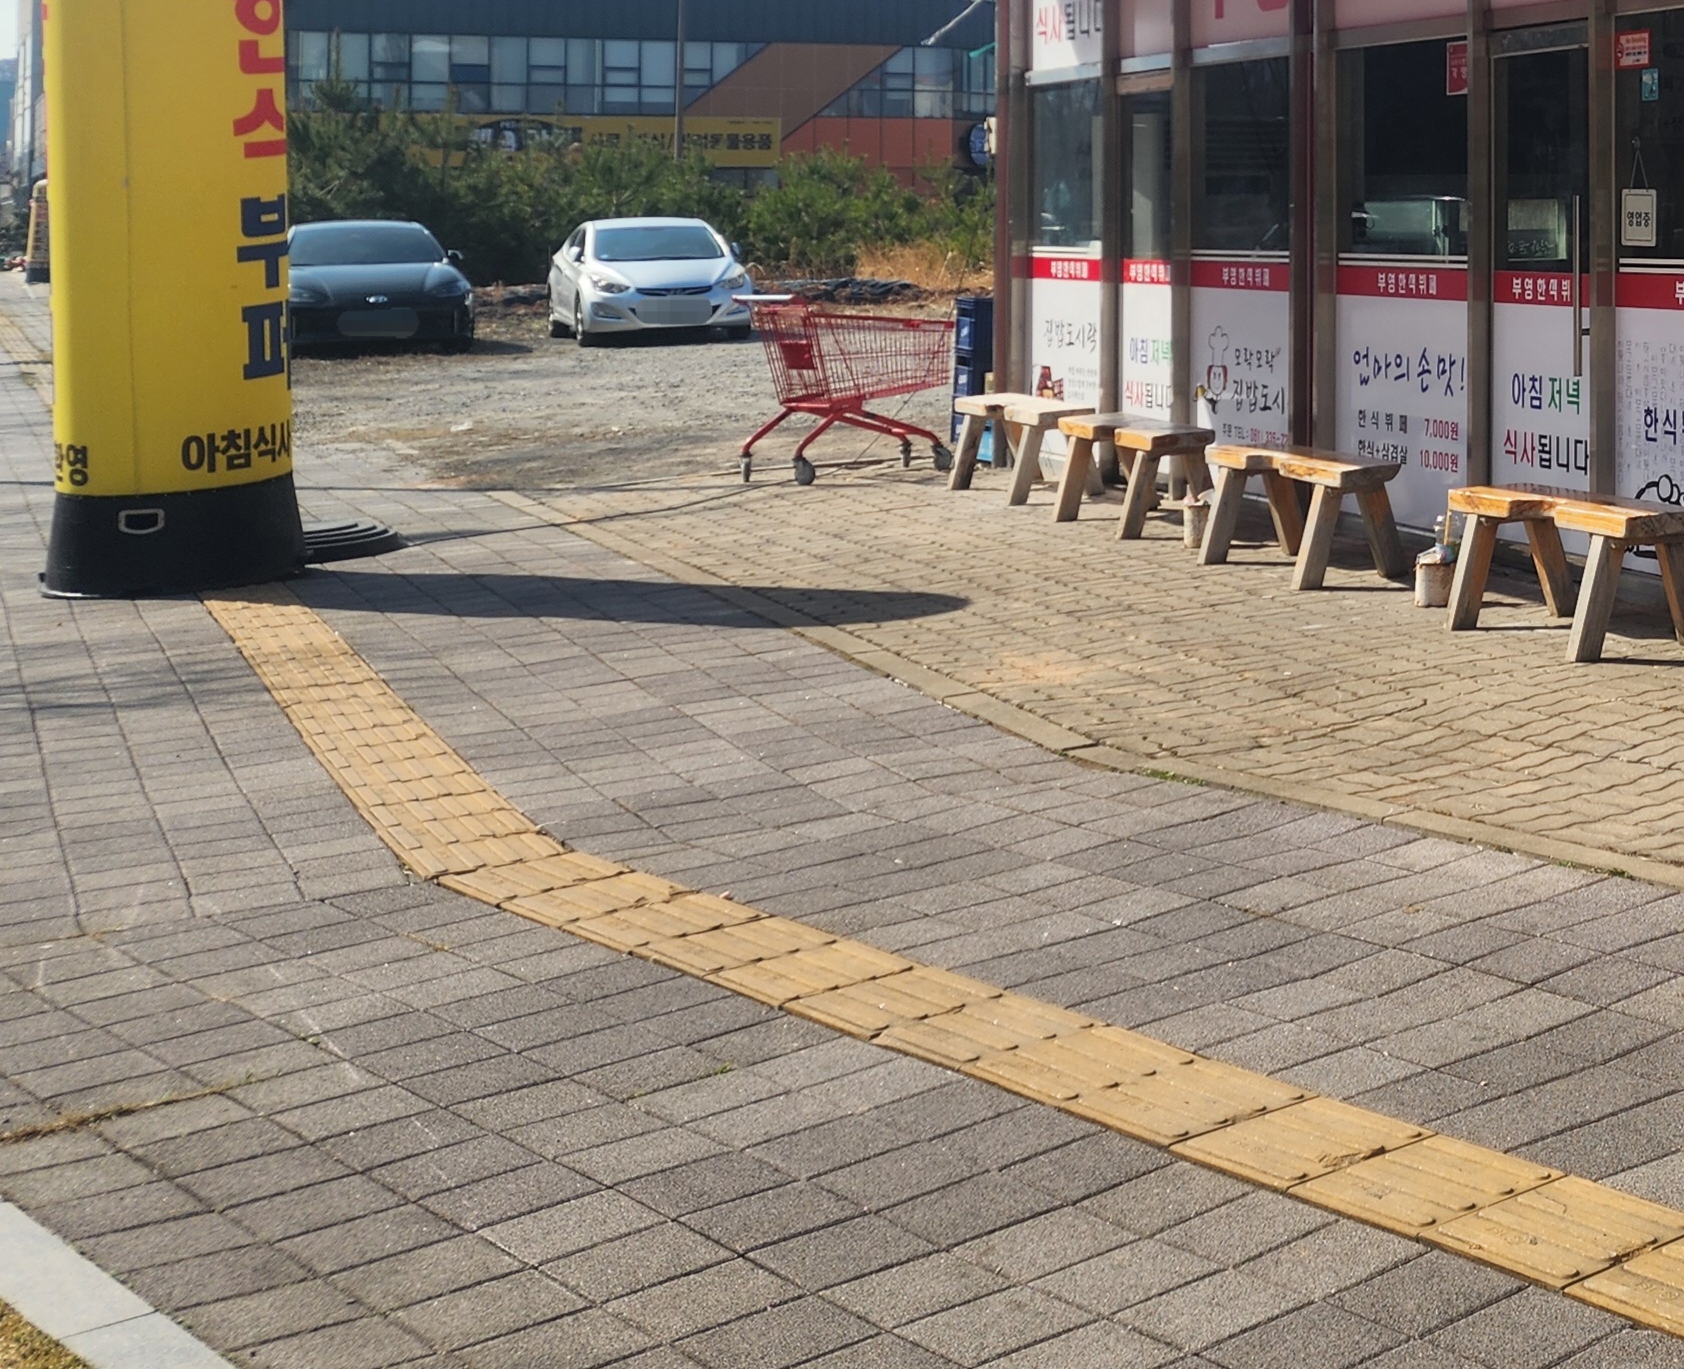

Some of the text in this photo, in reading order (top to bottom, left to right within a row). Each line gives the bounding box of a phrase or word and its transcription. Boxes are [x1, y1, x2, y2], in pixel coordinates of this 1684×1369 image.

[1626, 211, 1651, 228] 영업중
[1377, 272, 1437, 296] 부영한식뷔페
[1512, 276, 1571, 302] 부영한식뷔
[1353, 346, 1410, 386] 엄마의
[1511, 373, 1581, 415] 아침 저녁
[1424, 418, 1459, 441] 7,000원
[1419, 449, 1459, 473] 10,000원
